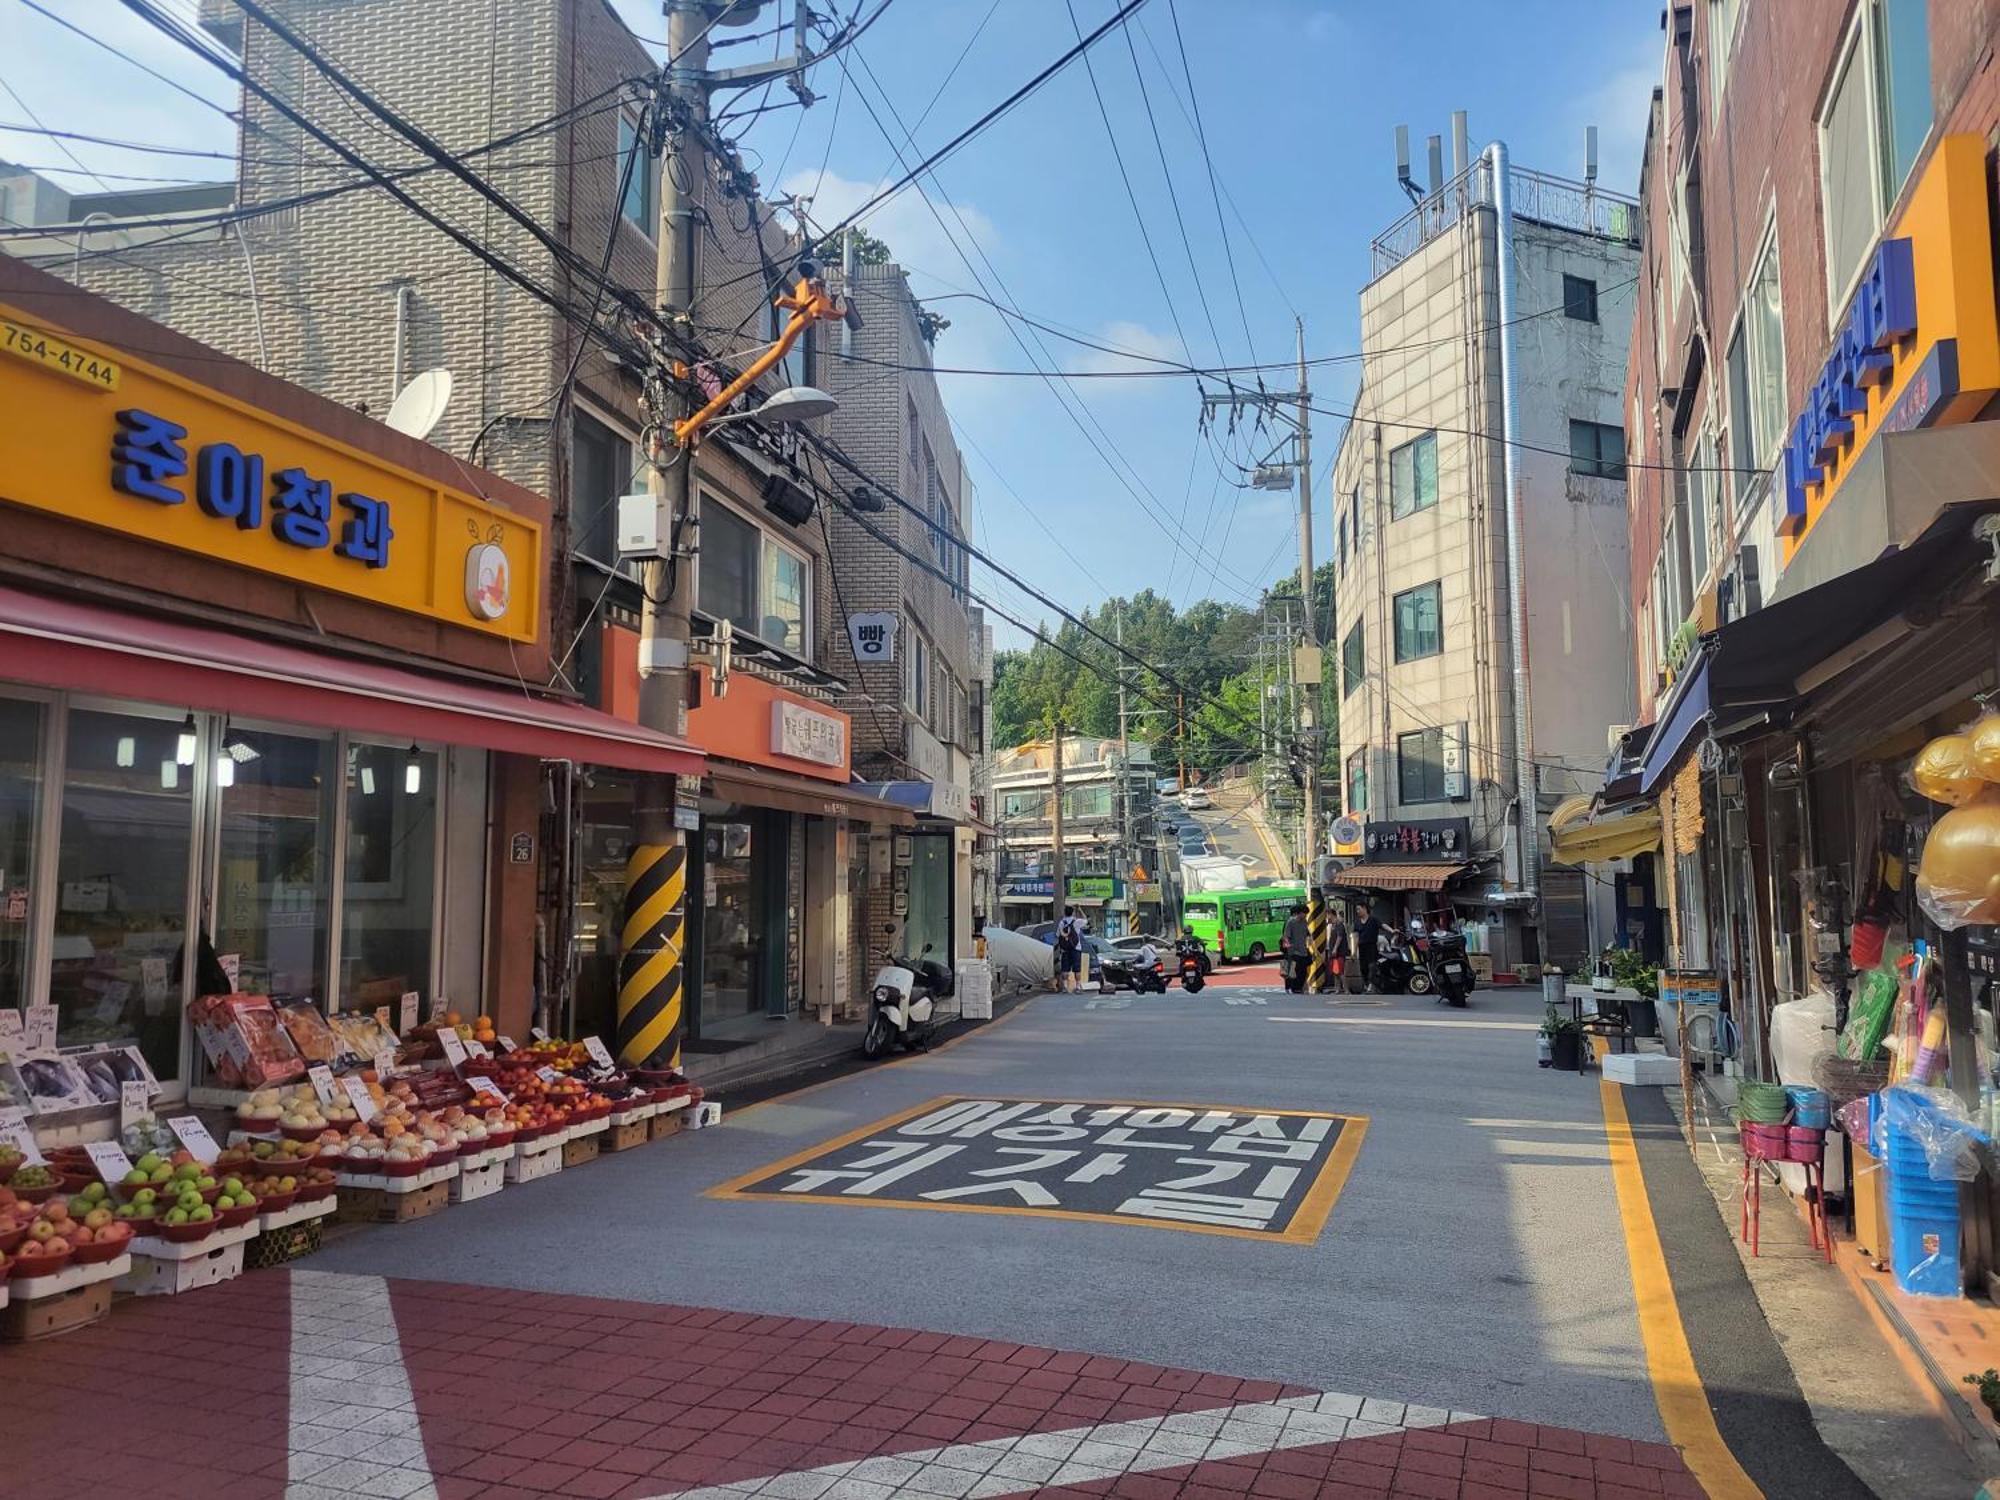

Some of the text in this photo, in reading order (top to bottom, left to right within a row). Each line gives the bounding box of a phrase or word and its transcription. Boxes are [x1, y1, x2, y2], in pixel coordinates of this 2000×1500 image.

[4, 326, 113, 385] 754-4744
[111, 408, 394, 569] 준이청과
[858, 624, 886, 653] 빵
[896, 1100, 1334, 1161] 여성안심
[780, 1141, 1302, 1230] 귀갓길
